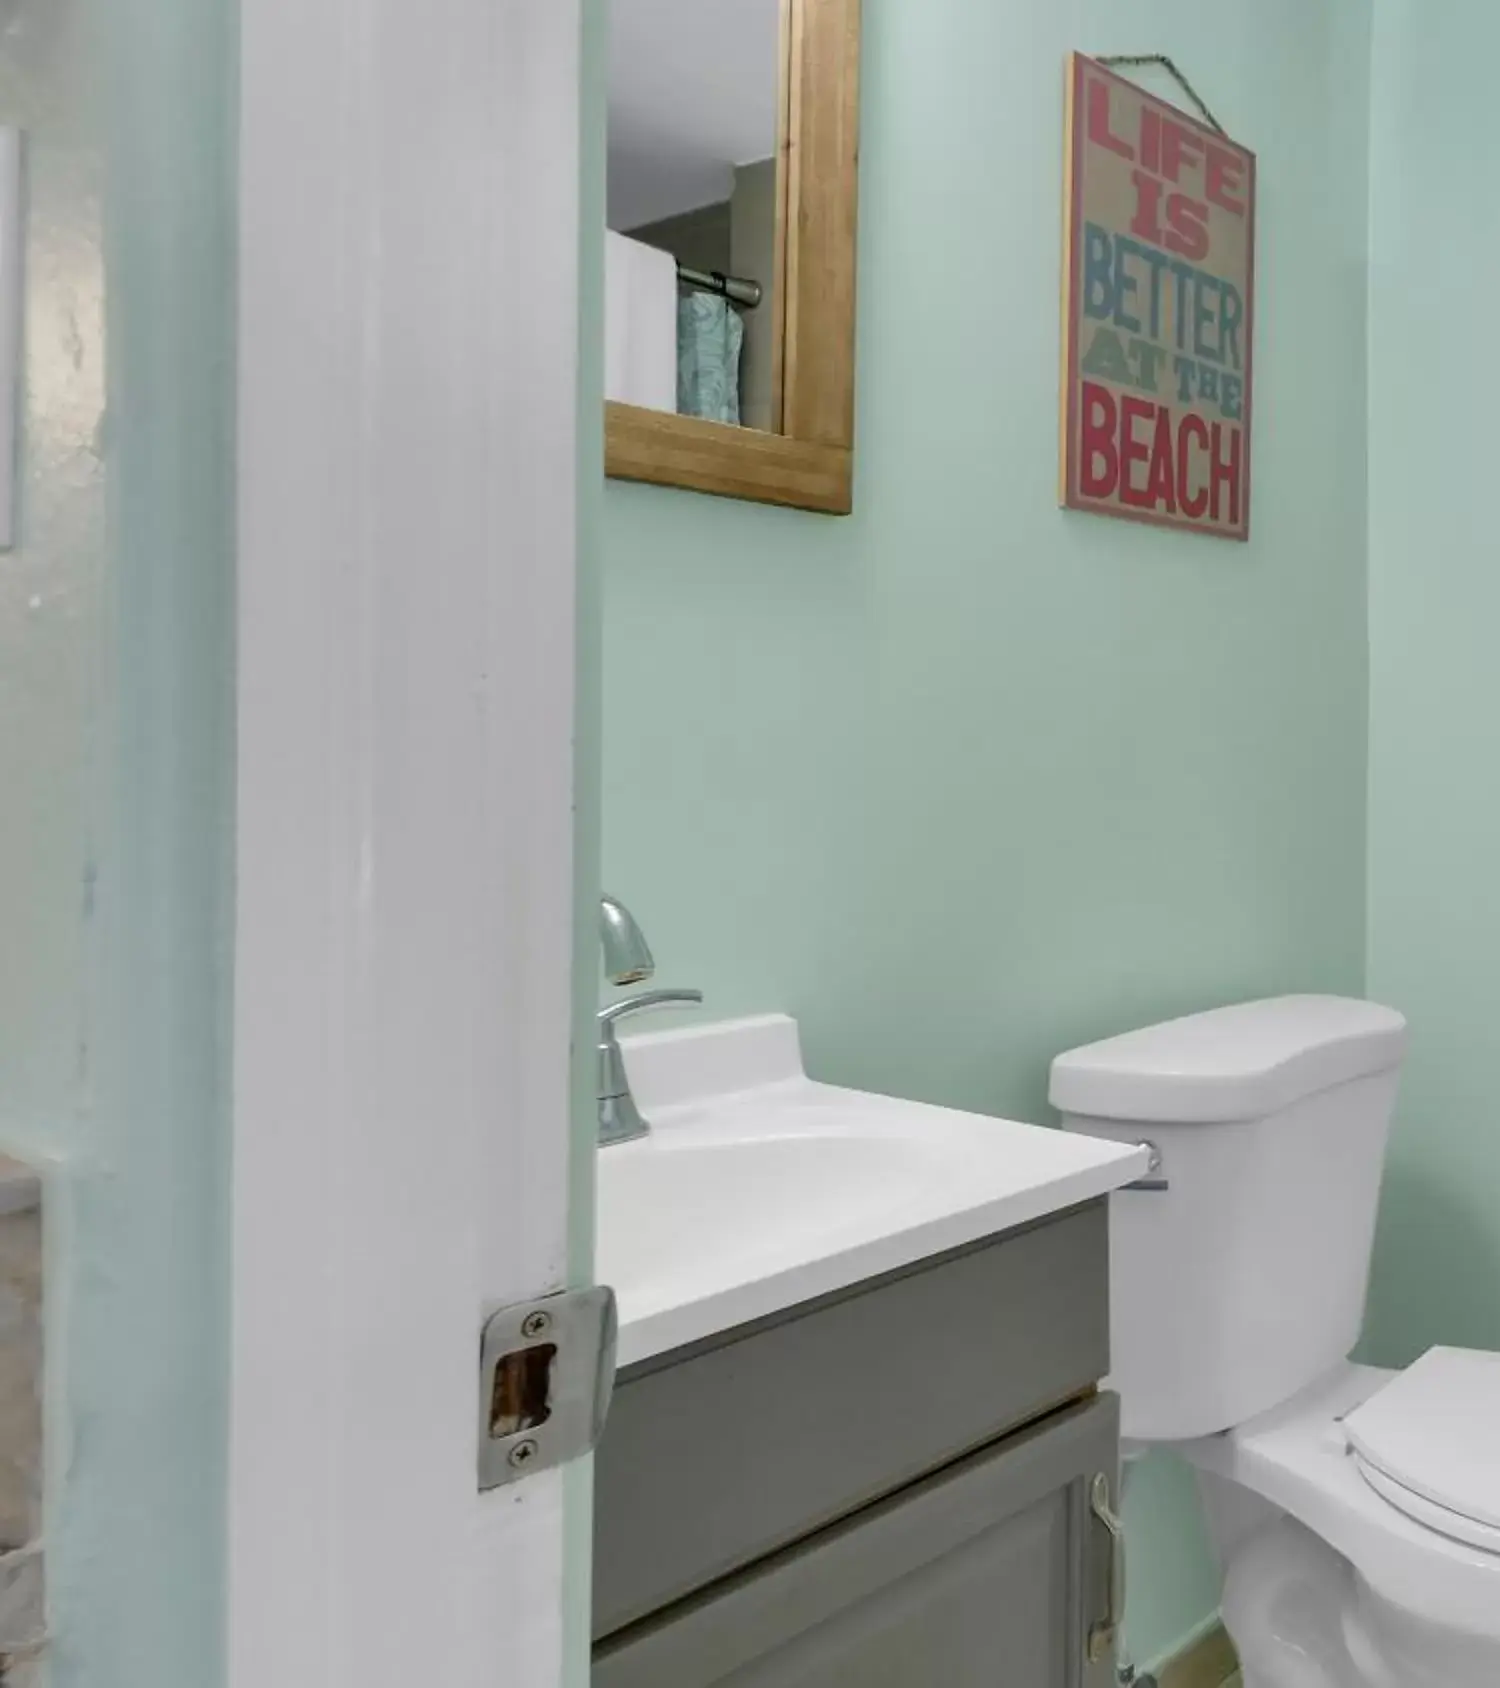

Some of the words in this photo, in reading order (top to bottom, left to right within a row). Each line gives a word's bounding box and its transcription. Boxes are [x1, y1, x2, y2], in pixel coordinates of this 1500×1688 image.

[1087, 78, 1244, 214] LIFE
[1131, 171, 1209, 260] IS
[1084, 221, 1242, 369] BETTER
[1082, 330, 1165, 392] AT
[1174, 355, 1242, 420] THE
[1080, 381, 1240, 524] BEACH
